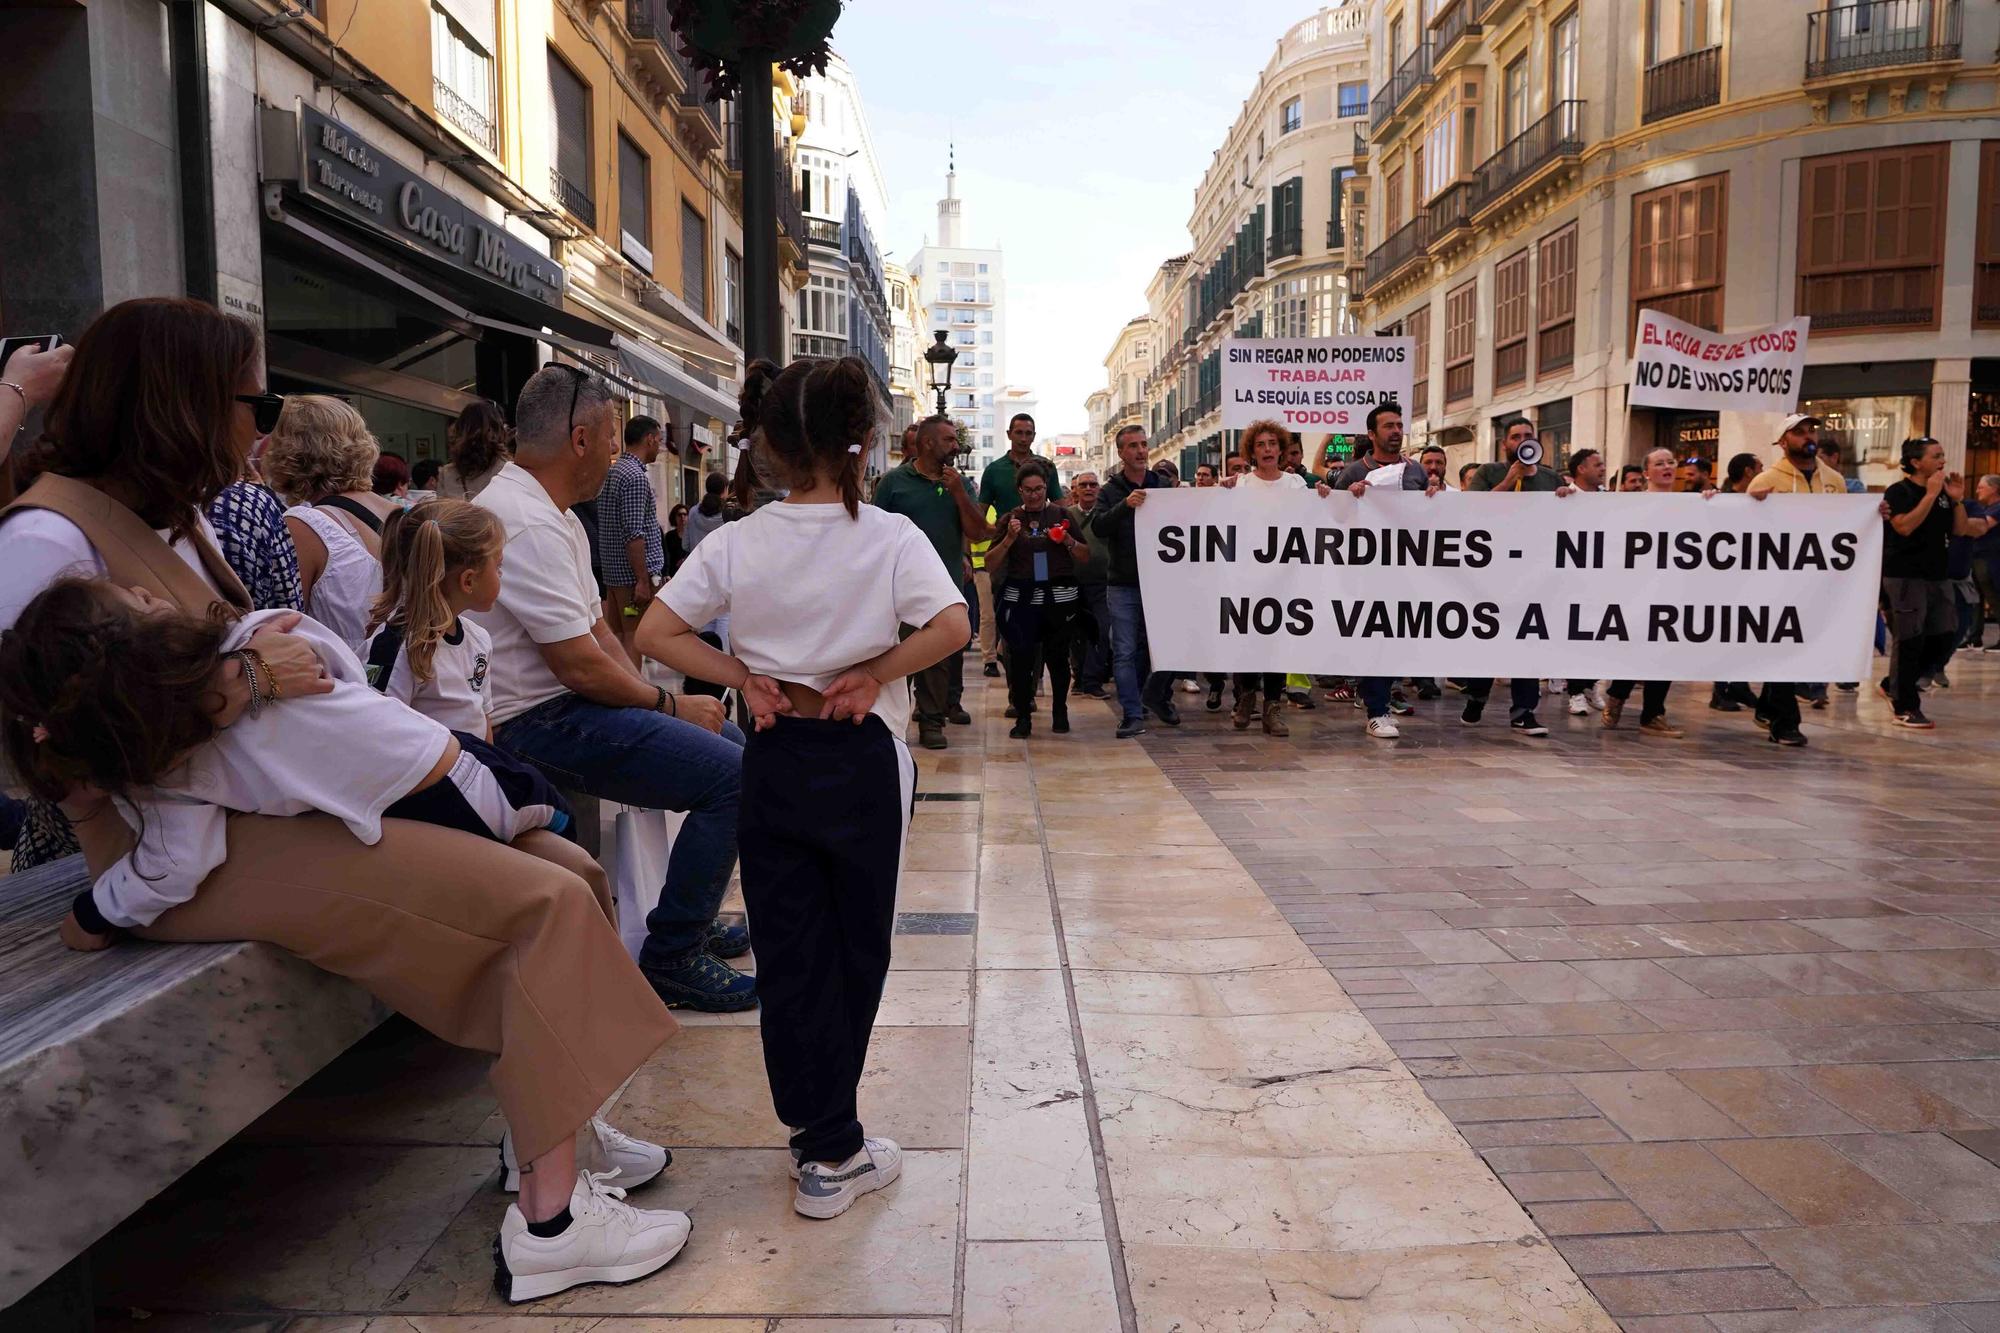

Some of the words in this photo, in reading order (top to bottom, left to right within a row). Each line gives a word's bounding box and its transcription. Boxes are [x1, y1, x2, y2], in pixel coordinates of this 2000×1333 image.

[322, 124, 380, 177] Helados
[317, 158, 383, 215] Turrones
[401, 180, 466, 255] Casa
[475, 225, 527, 289] Mira
[225, 296, 243, 309] CASA
[1229, 348, 1252, 363] SIN
[1255, 349, 1303, 363] REGAR
[1307, 347, 1328, 363] NO
[1331, 347, 1405, 363] PODEMOS
[1642, 323, 1663, 345] EL
[1665, 329, 1699, 358] AGUA
[1702, 343, 1725, 361] ES
[1724, 340, 1746, 361] DE
[1749, 330, 1797, 352] TODOS
[1268, 368, 1366, 382] TRABAJAR
[1636, 361, 1663, 387] NO
[1667, 364, 1691, 390] DE
[1693, 369, 1744, 393] UNOS
[1747, 368, 1792, 394] POCOS
[1235, 388, 1254, 403] LA
[1257, 386, 1311, 406] SEQUÍA
[1314, 391, 1332, 405] ES
[1336, 390, 1376, 405] COSA
[1378, 390, 1398, 406] DE
[1283, 410, 1349, 424] TODOS
[1680, 428, 1719, 442] SUARE
[1158, 525, 1236, 563] SIN
[1253, 527, 1492, 568] JARDINES
[1509, 550, 1522, 558] -
[1556, 531, 1604, 568] NI
[1625, 532, 1857, 571] PISCINAS
[1220, 597, 1313, 636] NOS
[1331, 600, 1499, 639] VAMOS
[1516, 603, 1549, 640] A
[1568, 604, 1629, 641] LA
[1648, 605, 1803, 643] RUINA
